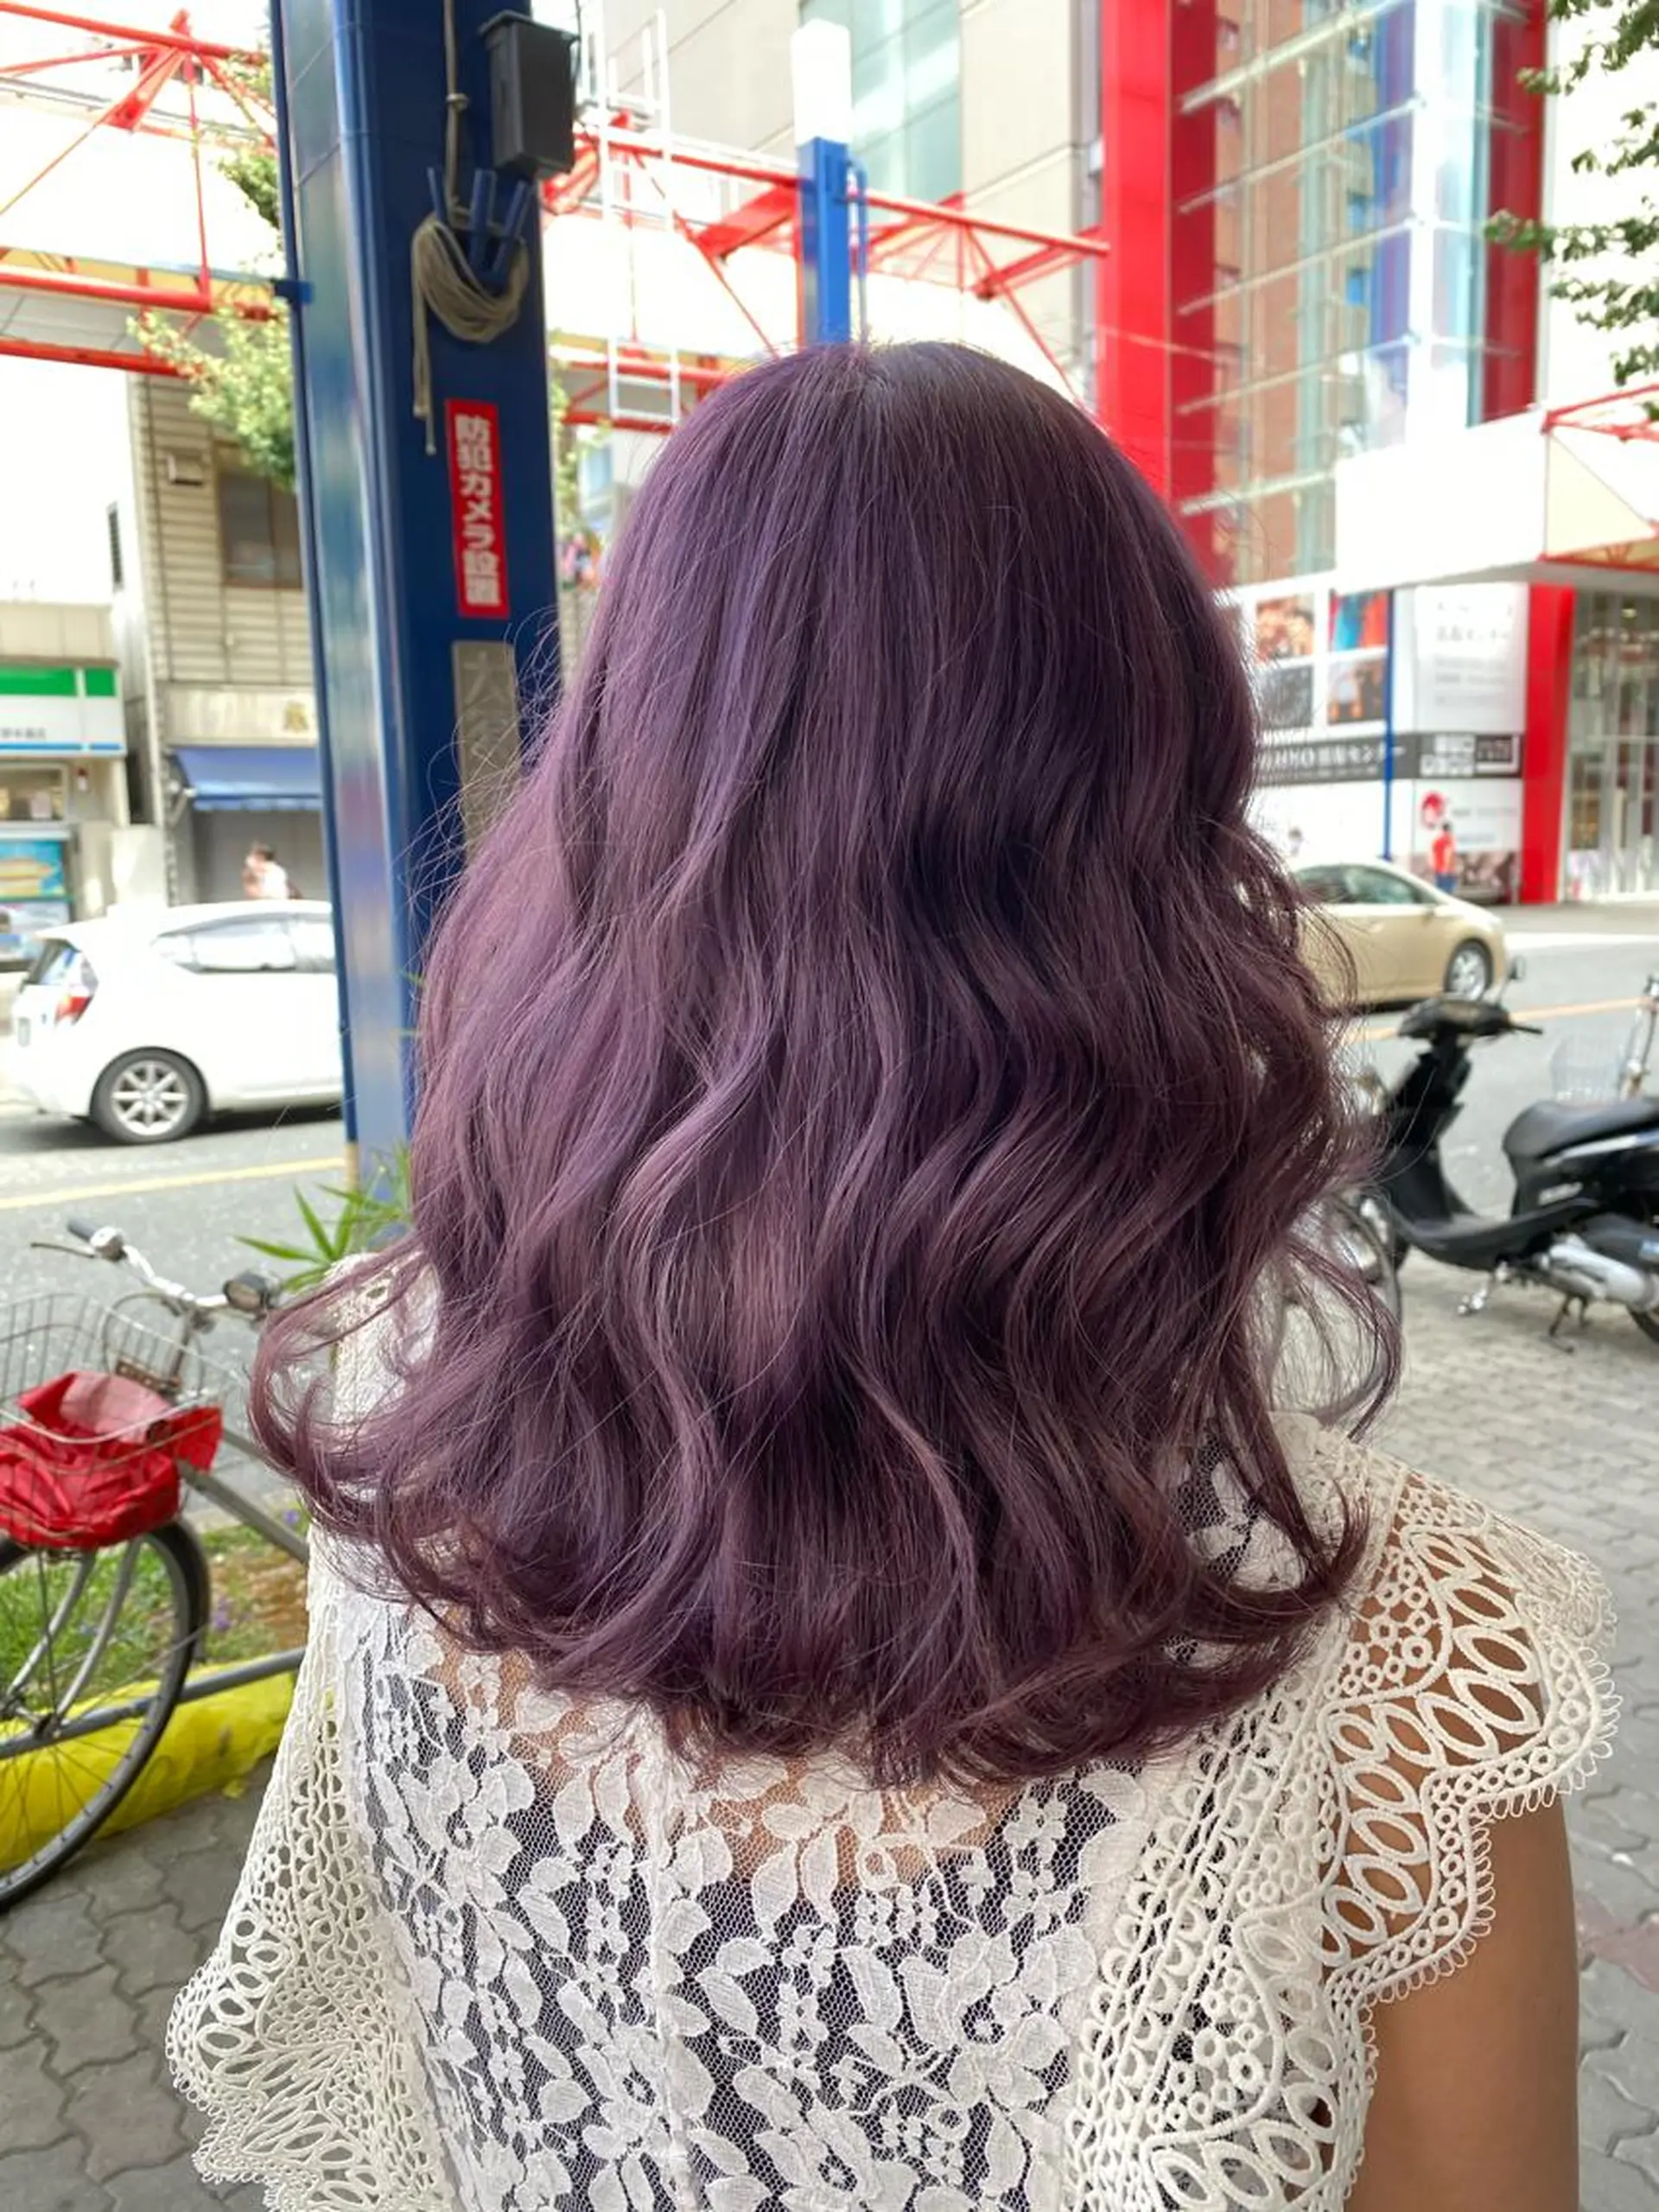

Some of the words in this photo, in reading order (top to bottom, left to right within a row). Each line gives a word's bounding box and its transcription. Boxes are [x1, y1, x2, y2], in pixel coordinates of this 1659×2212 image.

[454, 413, 502, 607] 防犯カメラ設置
